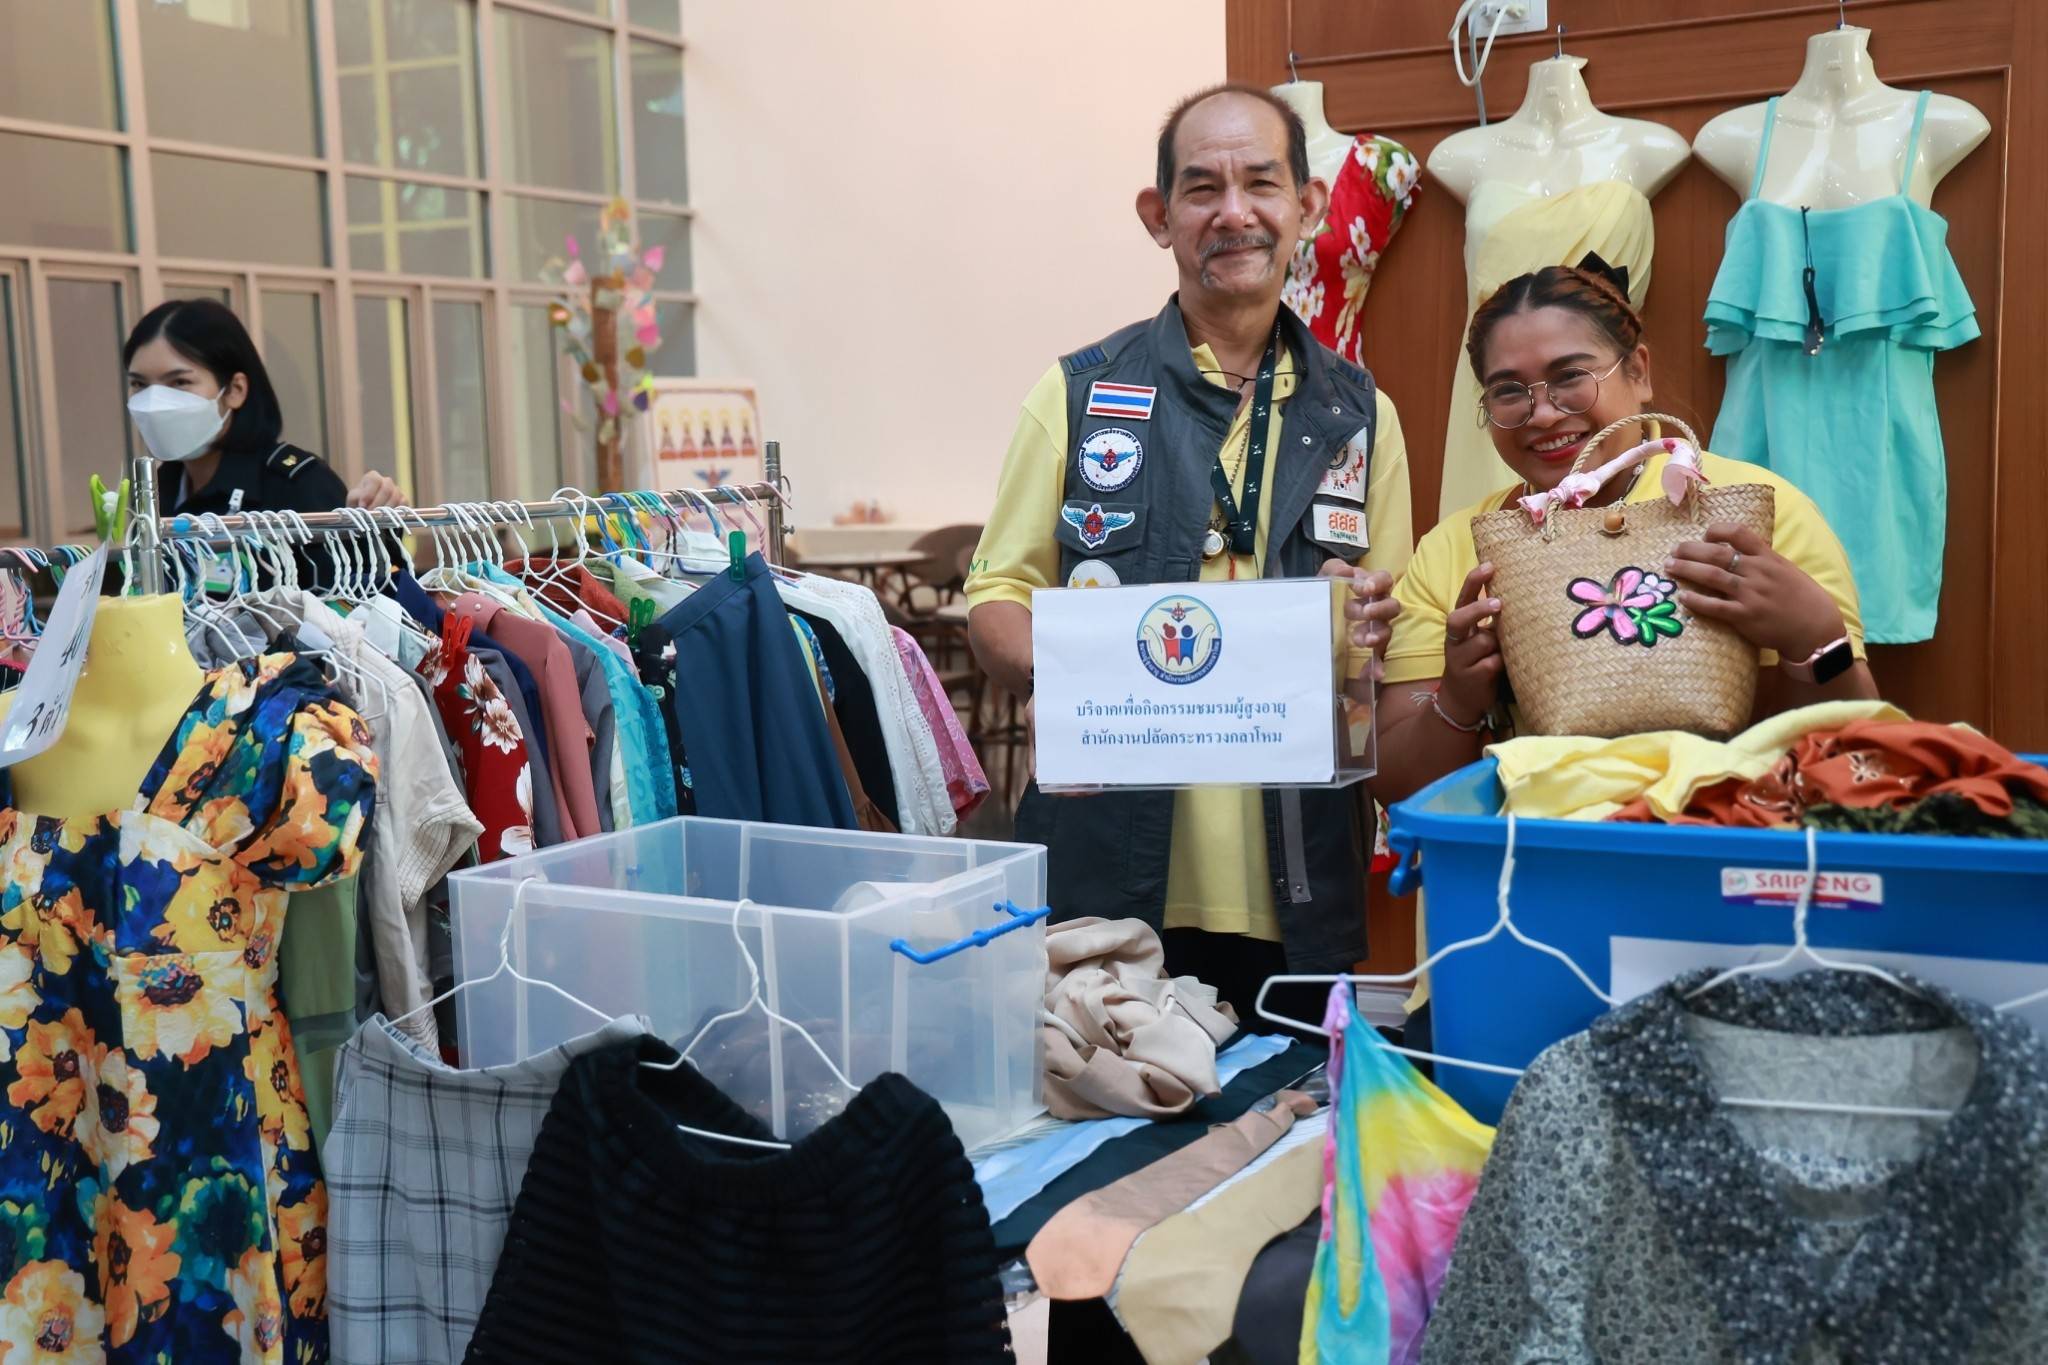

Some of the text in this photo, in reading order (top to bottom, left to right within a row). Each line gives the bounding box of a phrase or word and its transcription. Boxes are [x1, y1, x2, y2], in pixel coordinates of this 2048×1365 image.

[1076, 692, 1287, 719] บริจาคเพื่อกิจกรรมชมรมผู้สูงอายุ
[1081, 726, 1282, 745] สำนักงานปลัดกระทรวงกลาโหม
